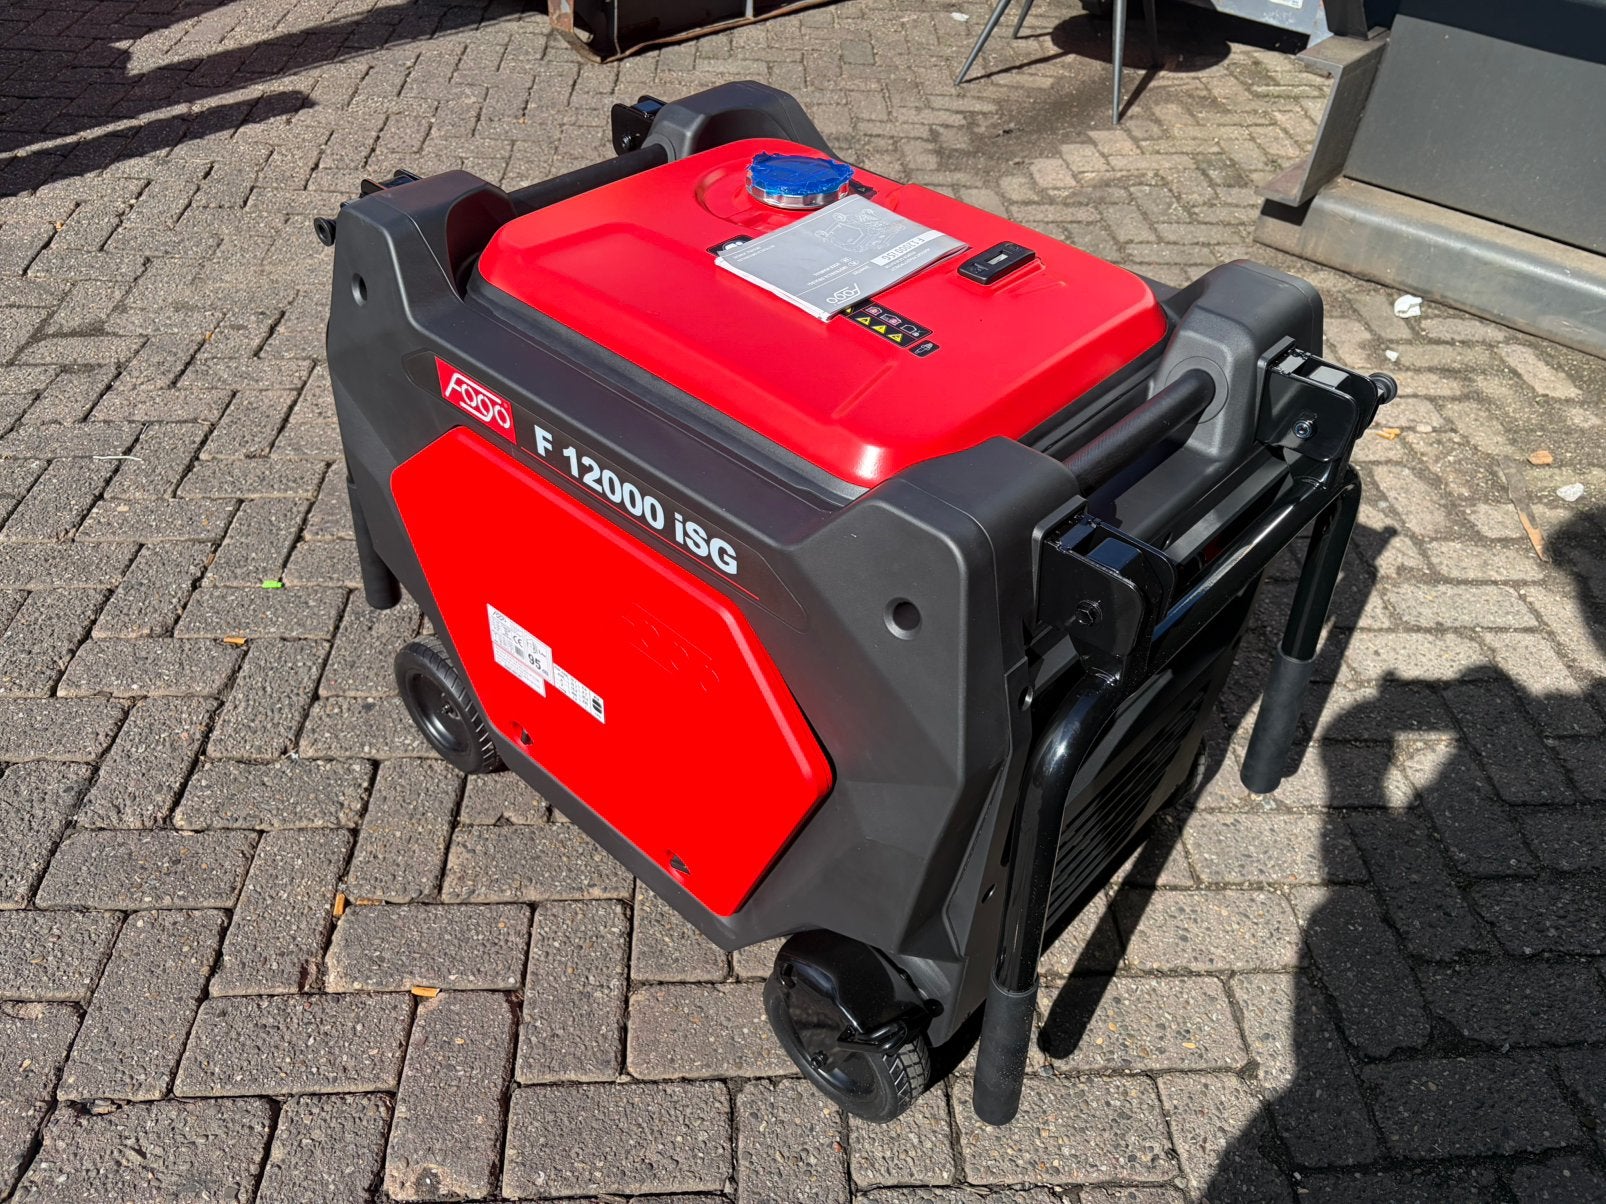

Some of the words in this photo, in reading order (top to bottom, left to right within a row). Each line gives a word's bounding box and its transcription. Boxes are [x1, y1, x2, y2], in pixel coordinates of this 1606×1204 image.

[534, 424, 553, 457] F
[562, 445, 665, 531] 12000
[674, 511, 738, 575] iSG
[528, 652, 542, 671] 95
